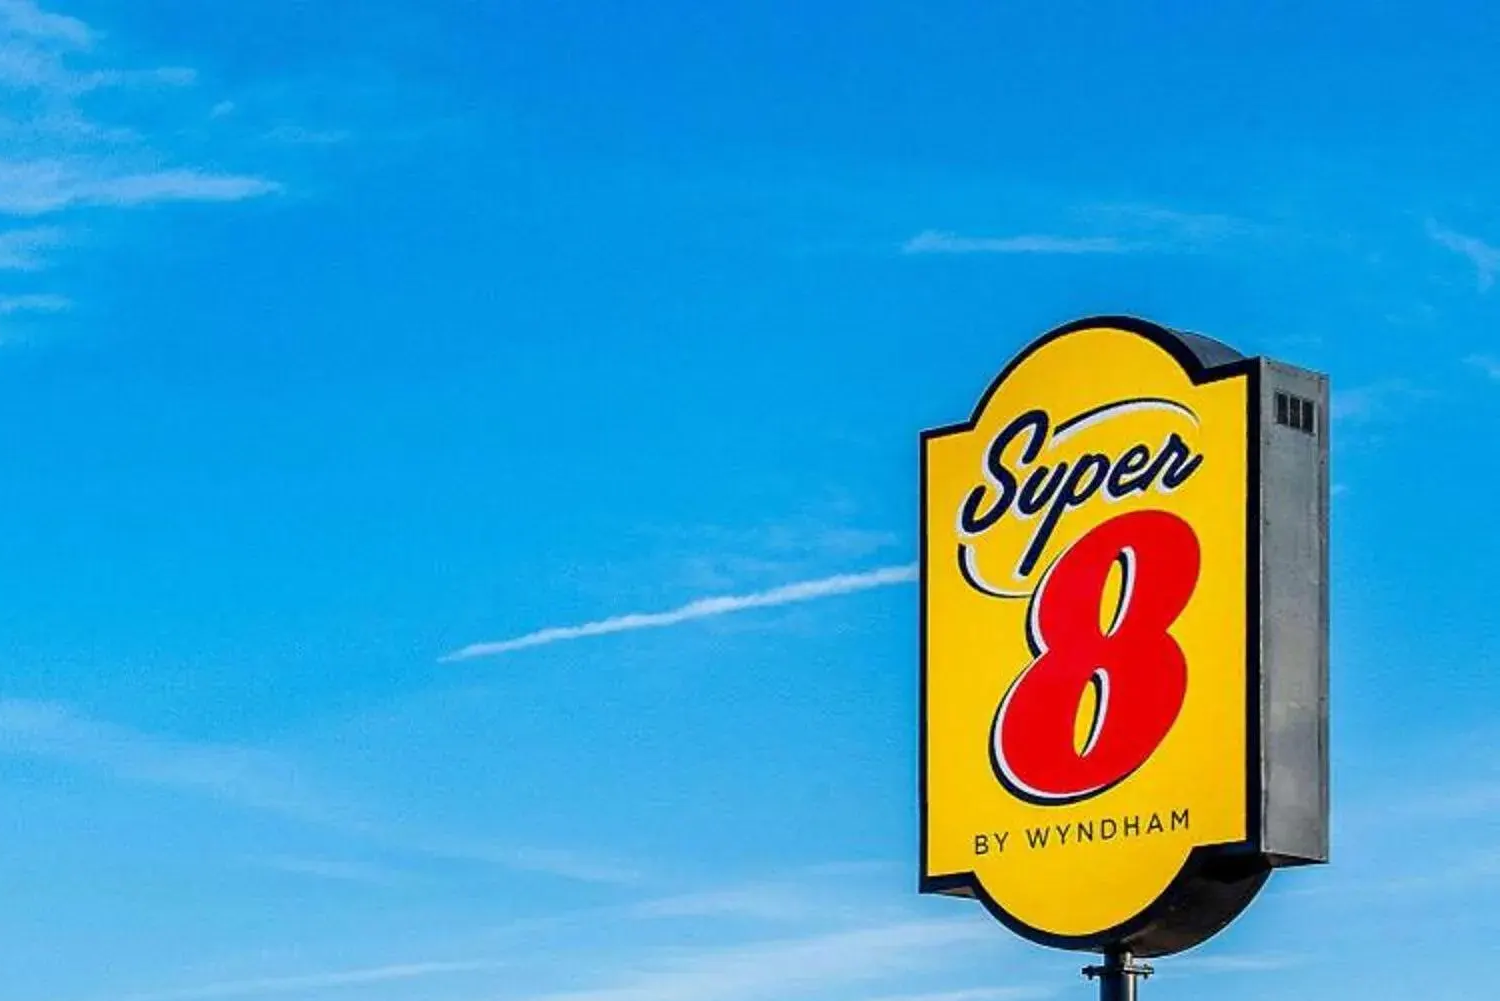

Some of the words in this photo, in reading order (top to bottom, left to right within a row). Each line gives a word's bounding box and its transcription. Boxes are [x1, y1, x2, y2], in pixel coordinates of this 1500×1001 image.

[958, 408, 1203, 579] Super
[988, 509, 1201, 807] 8
[974, 831, 1009, 856] BY
[1025, 807, 1190, 850] WYNDHAM
